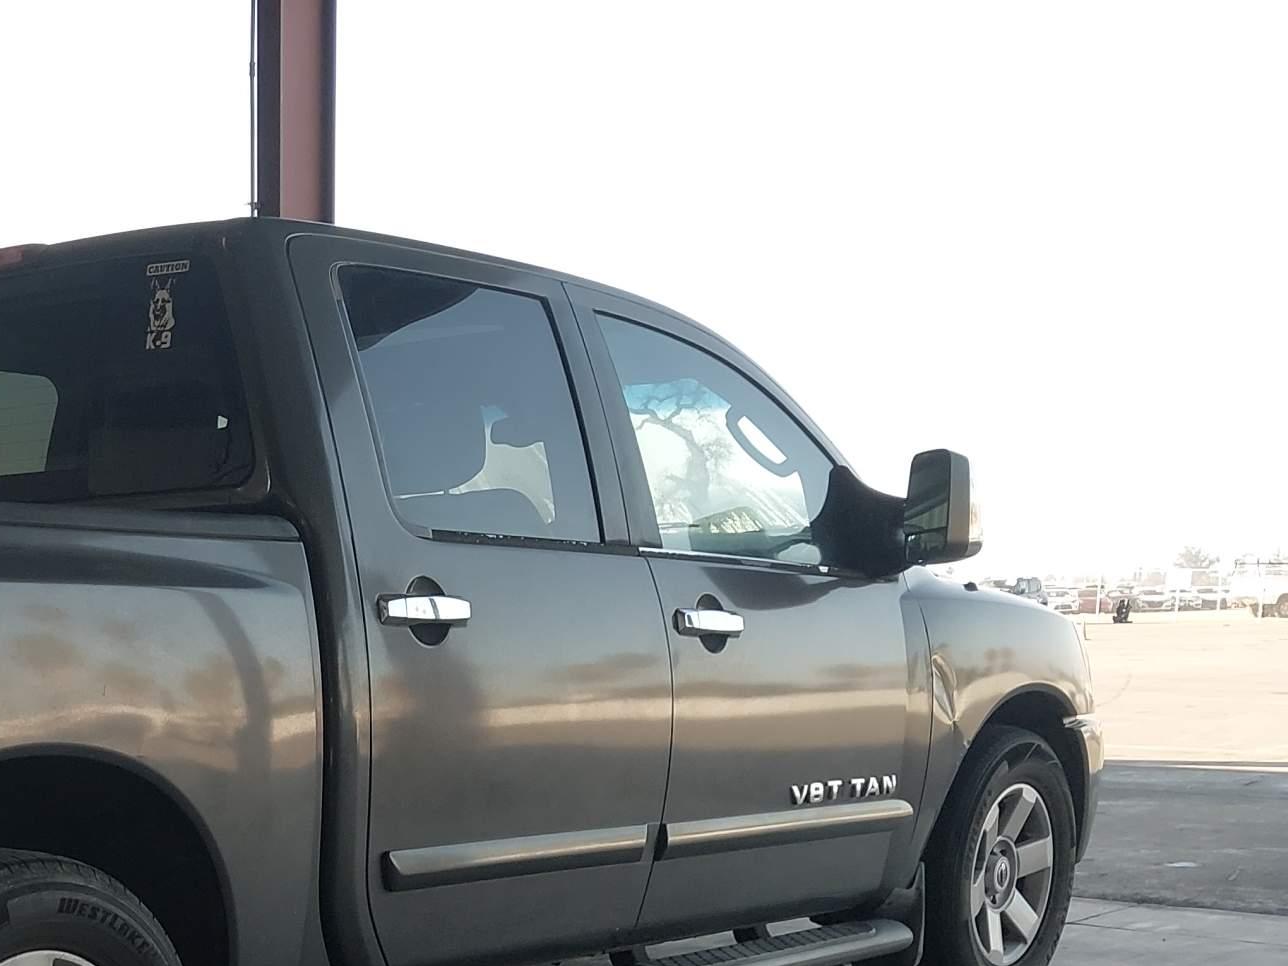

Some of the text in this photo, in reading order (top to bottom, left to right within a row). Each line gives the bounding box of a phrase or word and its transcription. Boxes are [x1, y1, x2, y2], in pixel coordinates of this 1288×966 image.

[148, 261, 189, 274] CAUTION
[850, 774, 897, 798] TAN
[56, 897, 150, 955] WESTLAKE
